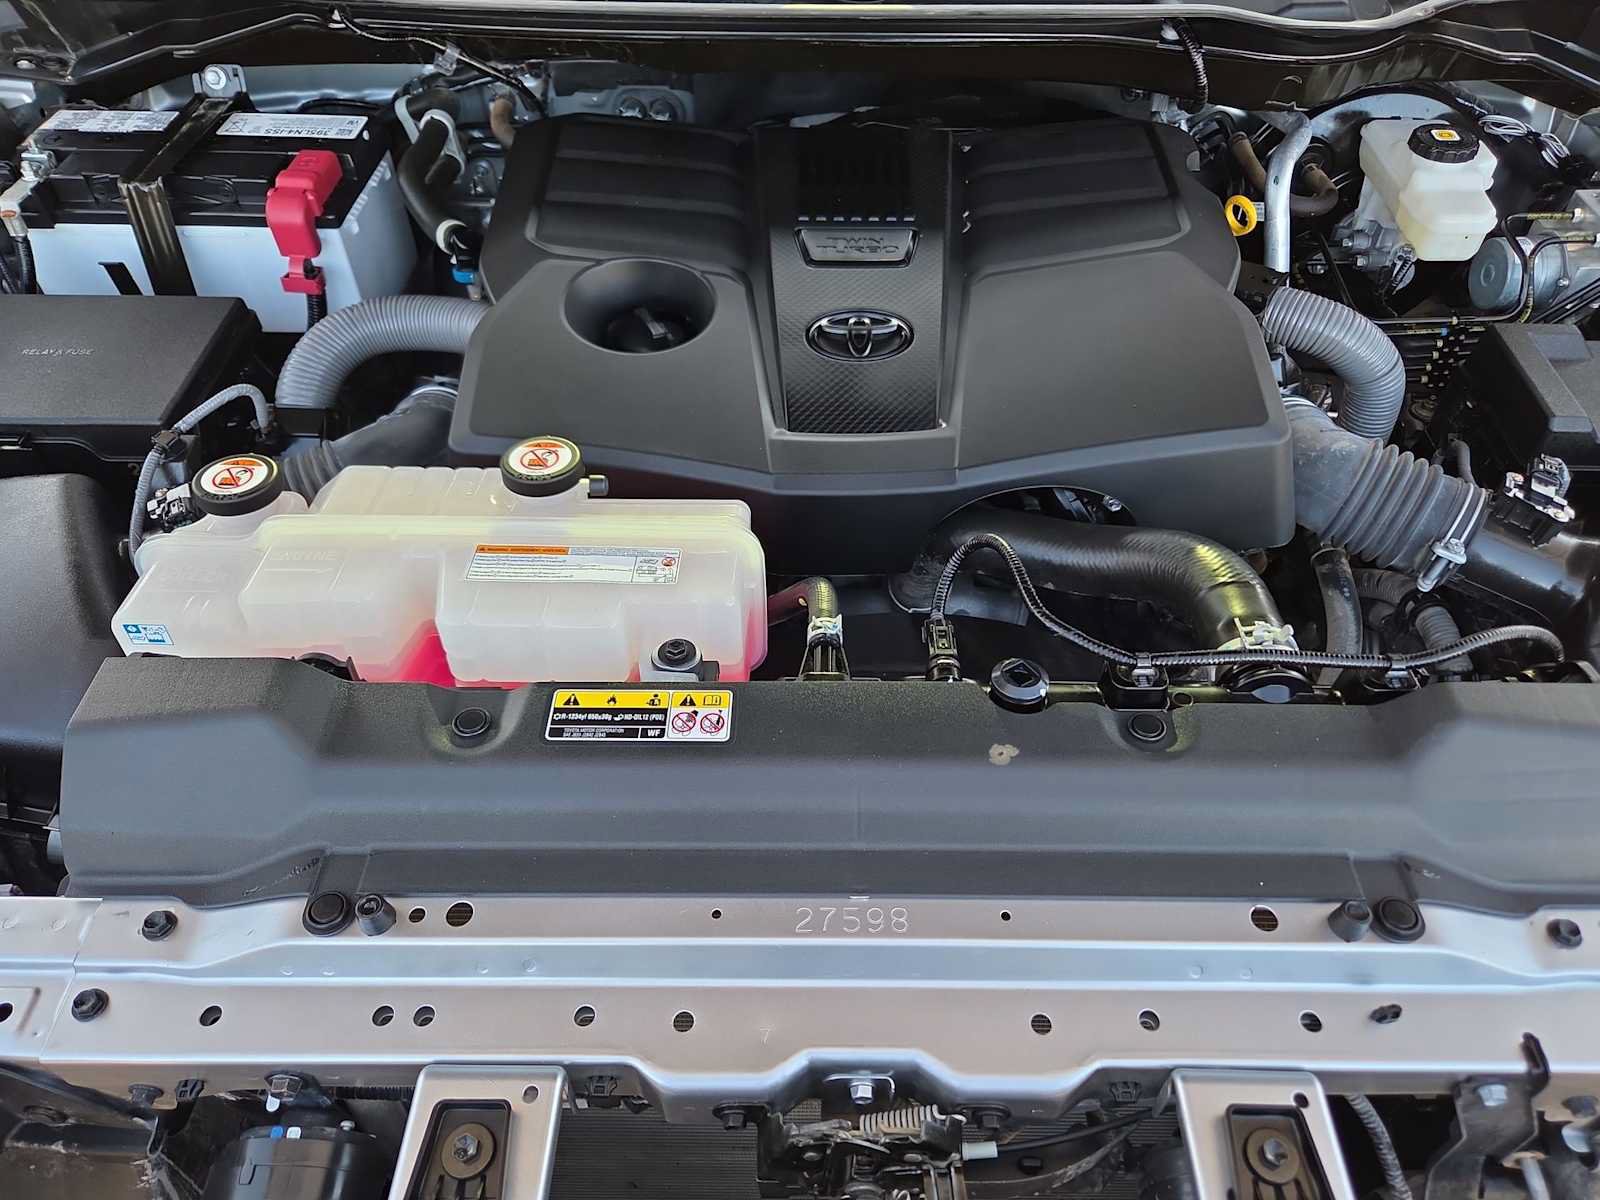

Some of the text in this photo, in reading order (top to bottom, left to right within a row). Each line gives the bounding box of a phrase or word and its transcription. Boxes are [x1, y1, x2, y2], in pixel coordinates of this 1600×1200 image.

[826, 237, 884, 245] TWIN
[816, 245, 900, 254] TURBO
[65, 348, 95, 356] FUSE
[647, 729, 661, 737] WF
[795, 907, 909, 933] 27598
